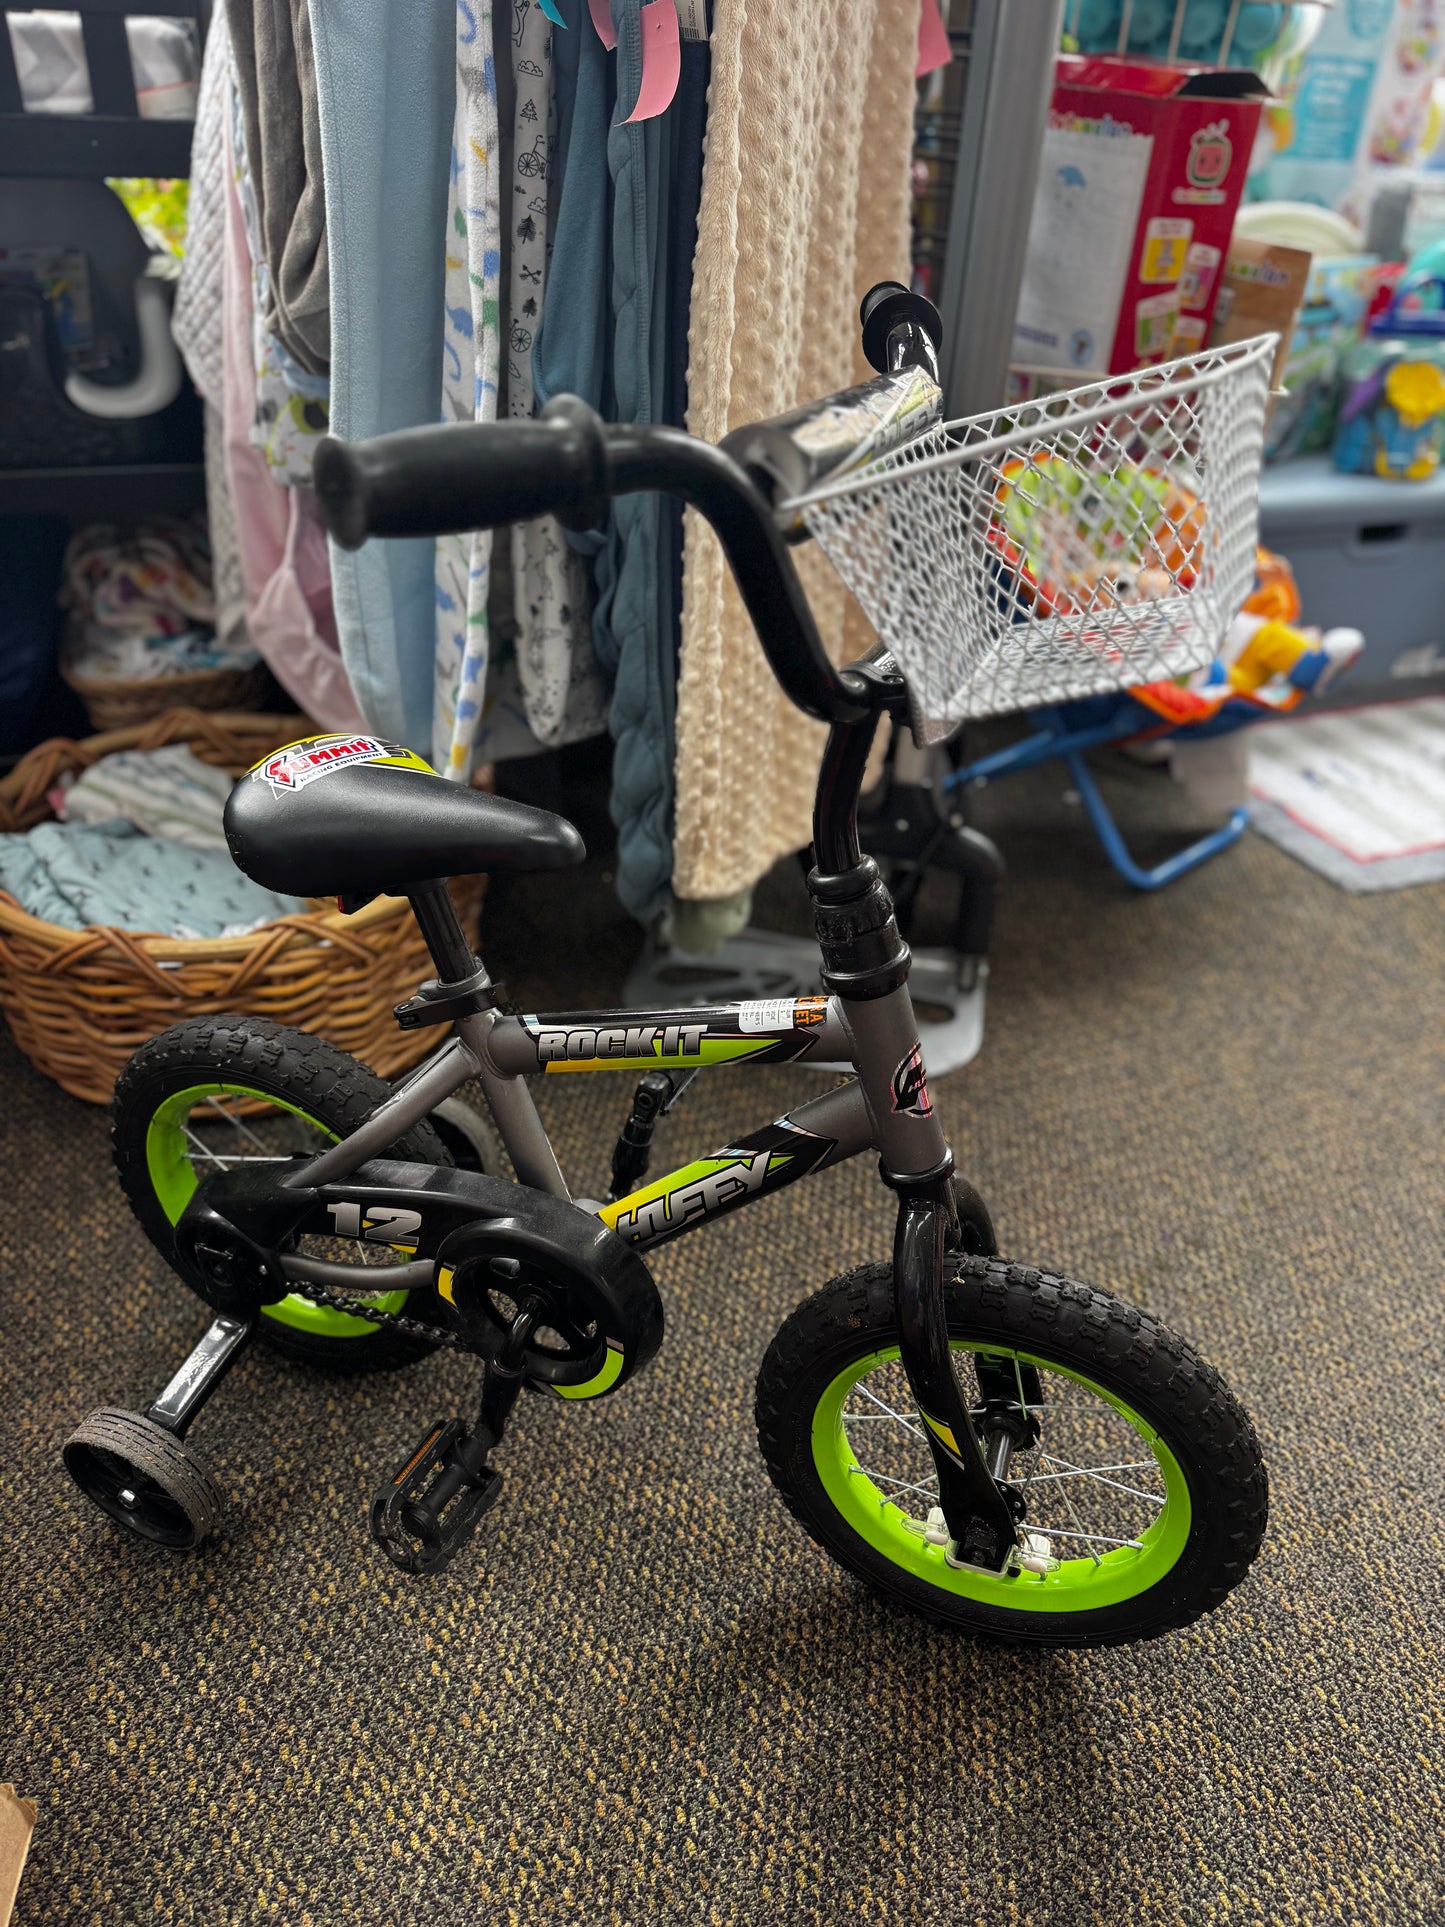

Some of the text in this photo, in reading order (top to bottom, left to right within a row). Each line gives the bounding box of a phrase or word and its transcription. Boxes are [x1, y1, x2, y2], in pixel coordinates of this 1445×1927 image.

[334, 752, 384, 768] EQUIPMENT
[617, 1150, 772, 1246] HUFFY
[326, 1201, 422, 1246] 12
